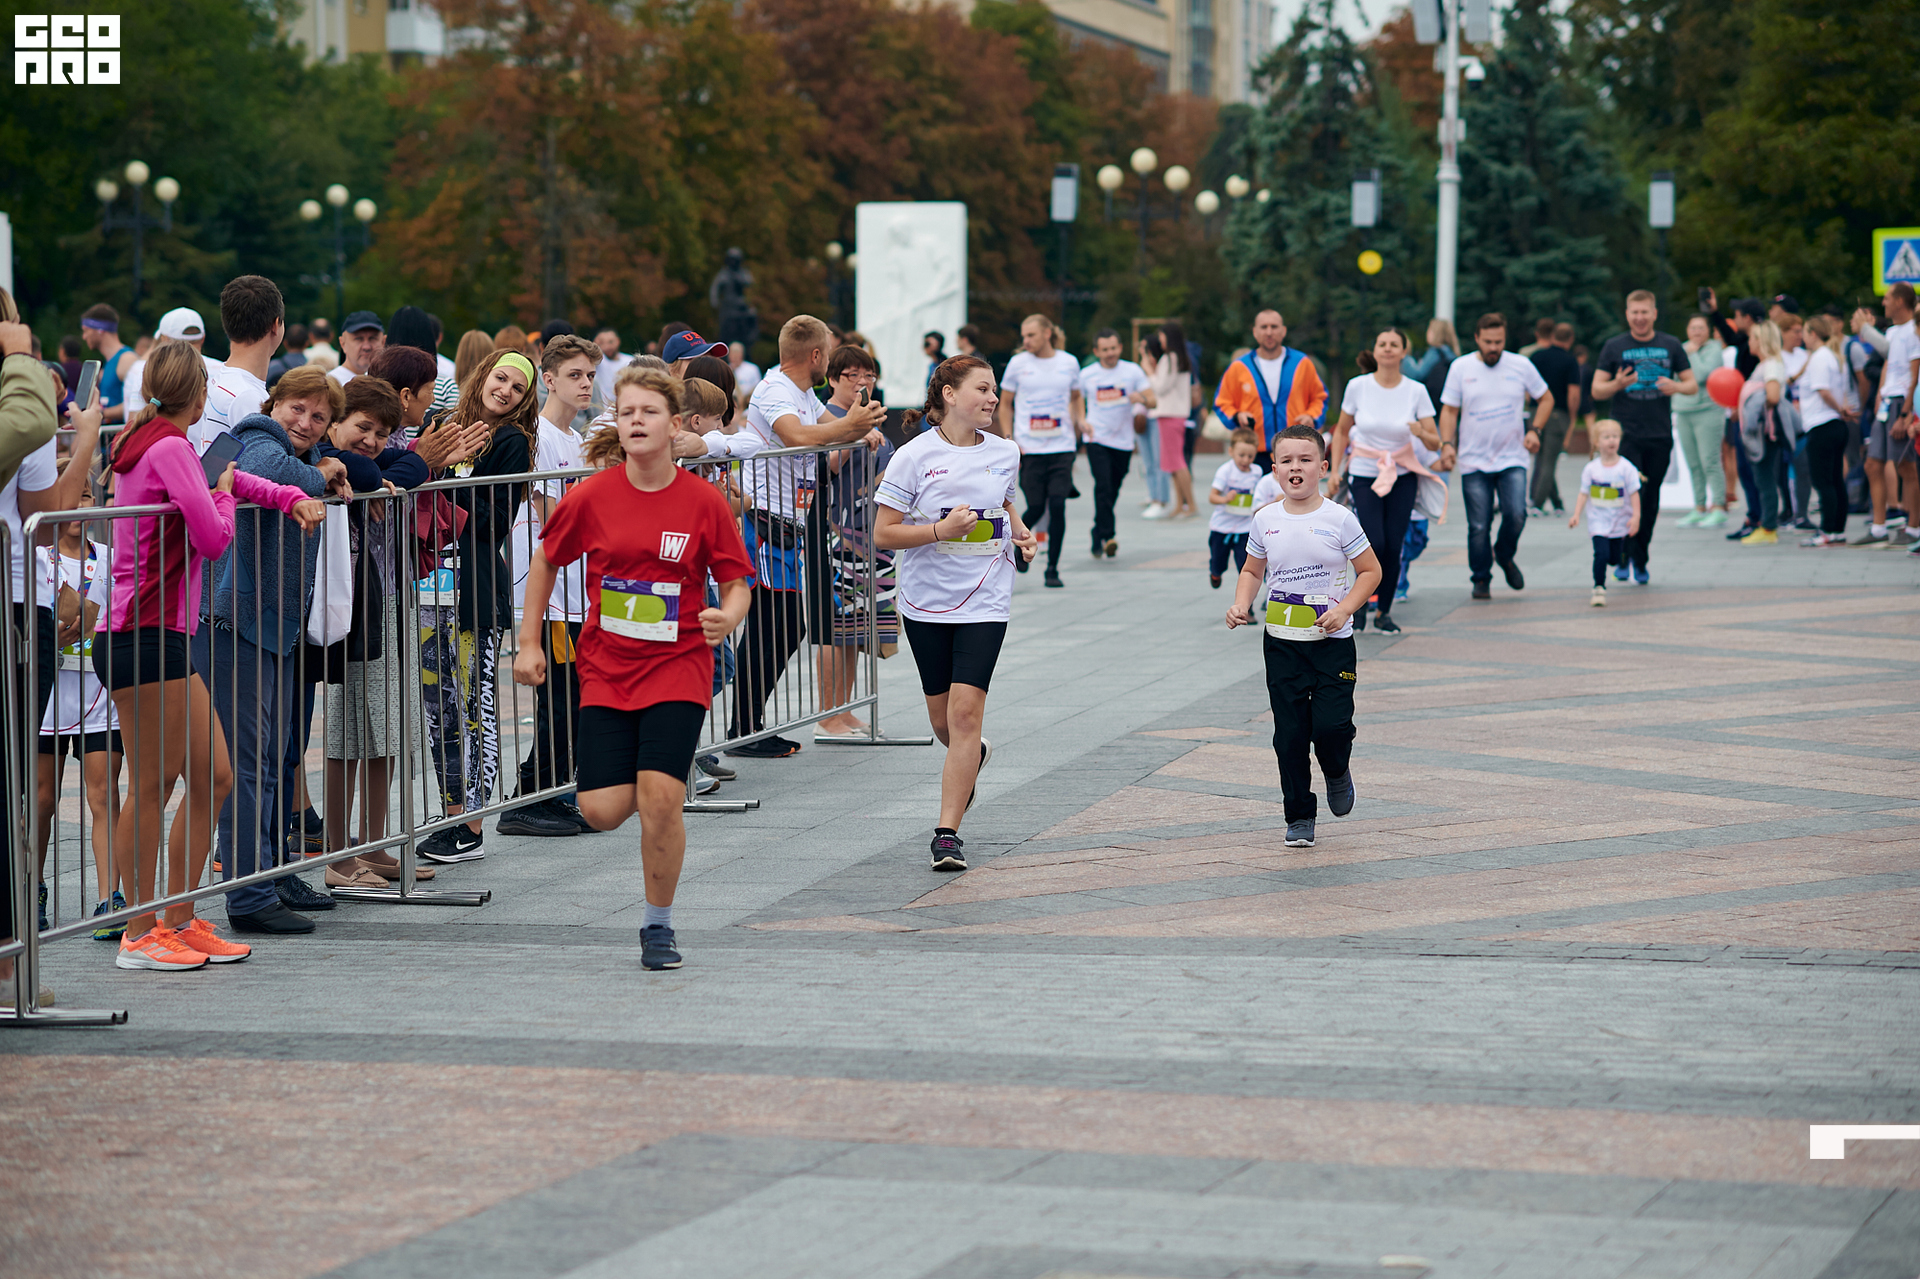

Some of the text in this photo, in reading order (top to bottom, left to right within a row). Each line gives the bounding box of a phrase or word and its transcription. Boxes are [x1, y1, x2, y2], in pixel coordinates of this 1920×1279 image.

[664, 536, 684, 558] W
[624, 596, 637, 620] 1
[1283, 605, 1292, 625] 1
[480, 681, 498, 790] DOMINATION
